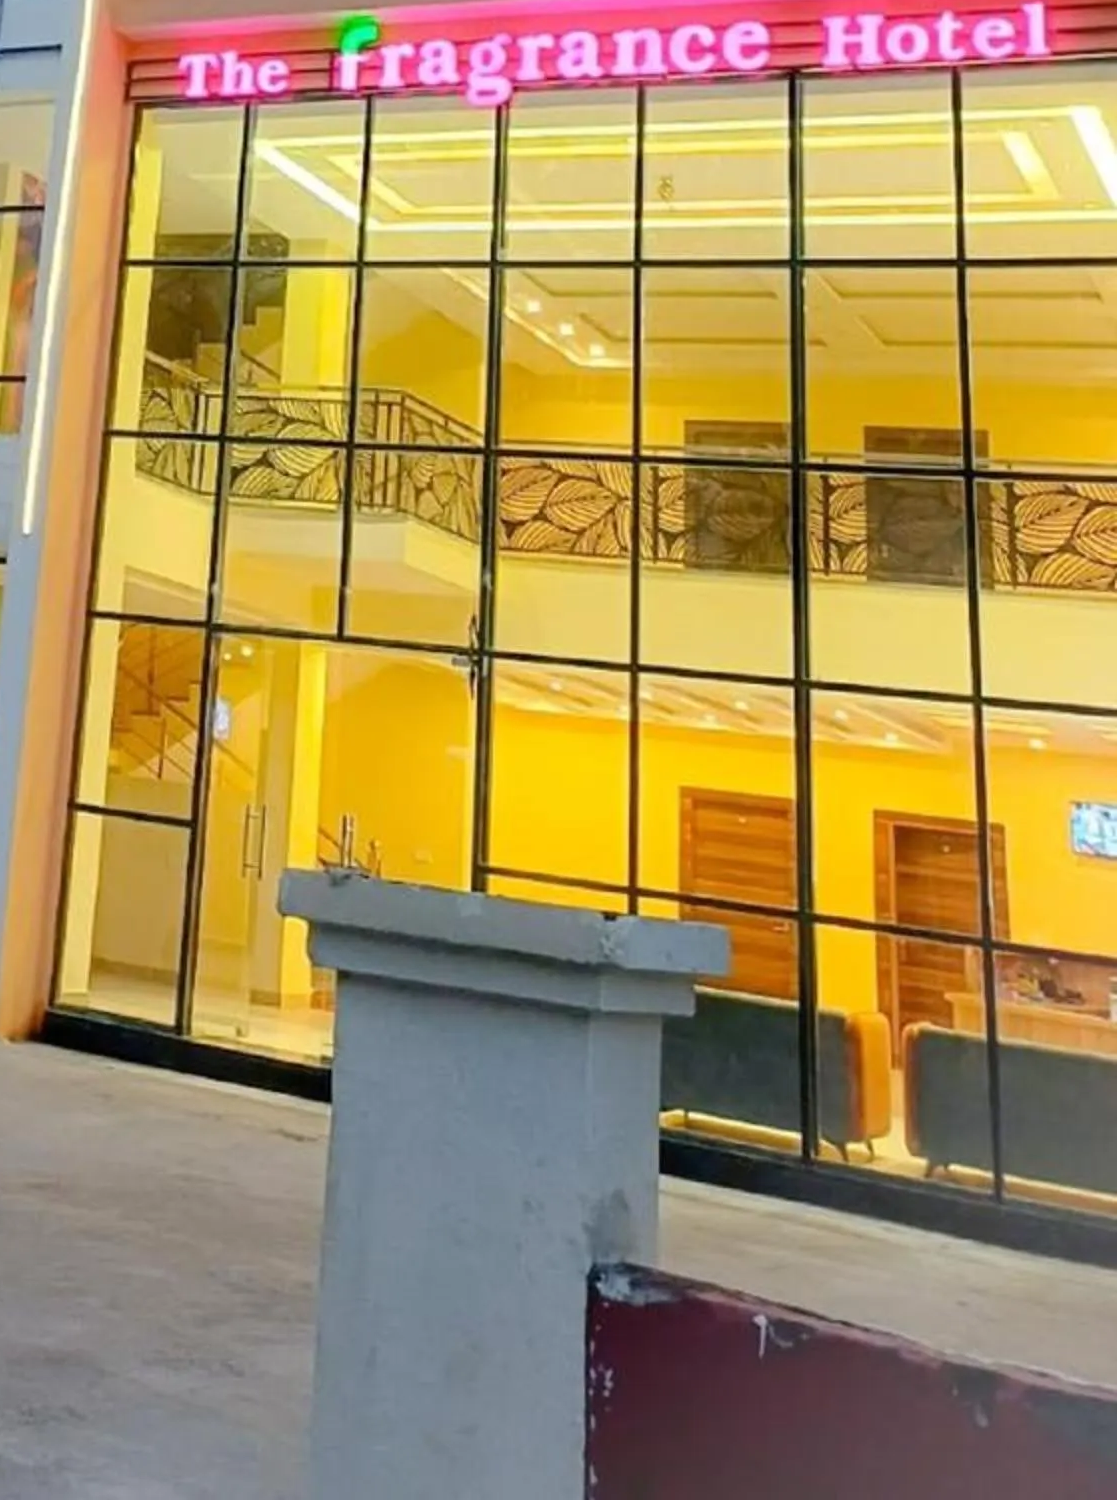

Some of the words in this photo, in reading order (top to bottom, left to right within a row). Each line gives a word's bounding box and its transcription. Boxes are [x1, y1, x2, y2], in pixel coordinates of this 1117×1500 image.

[179, 50, 290, 97] The
[336, 16, 771, 106] fragrance
[821, 1, 1053, 69] Hotel
